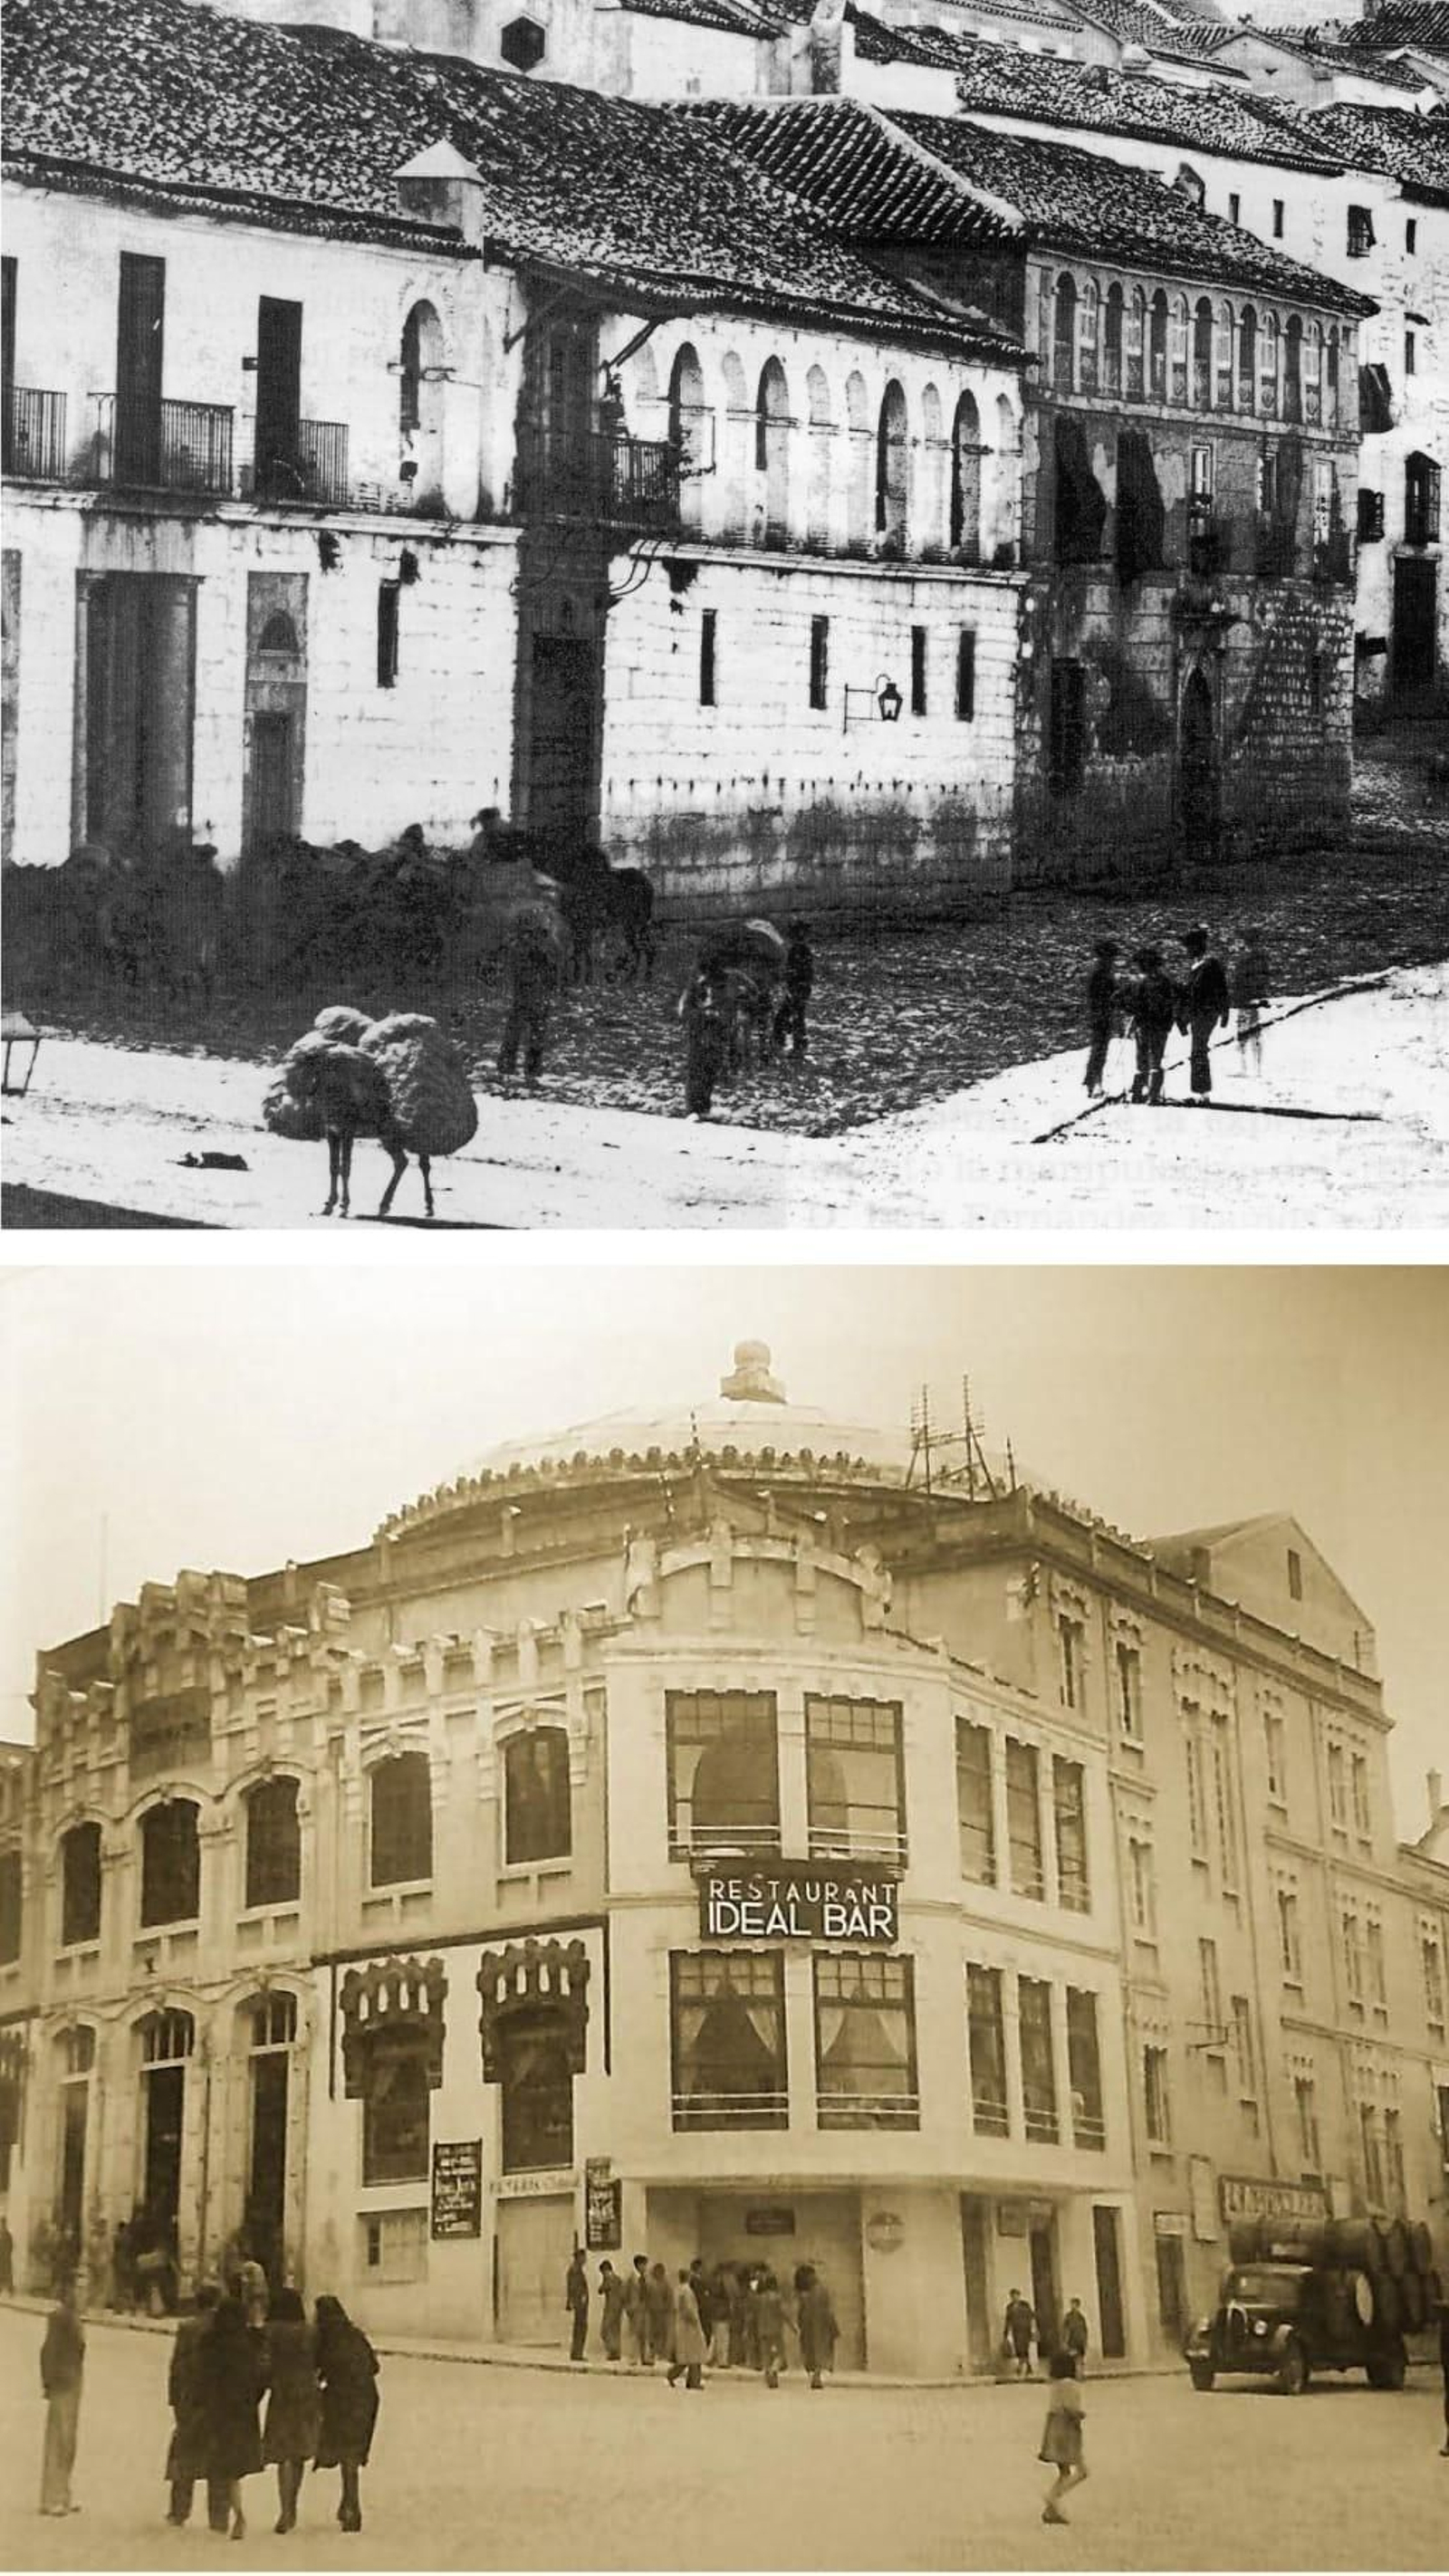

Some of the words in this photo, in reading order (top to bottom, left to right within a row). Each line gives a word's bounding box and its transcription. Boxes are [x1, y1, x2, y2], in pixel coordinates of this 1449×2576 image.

[709, 1879, 895, 1904] RESTAURANT
[708, 1901, 811, 1937] IDEAL
[823, 1904, 895, 1938] BAR
